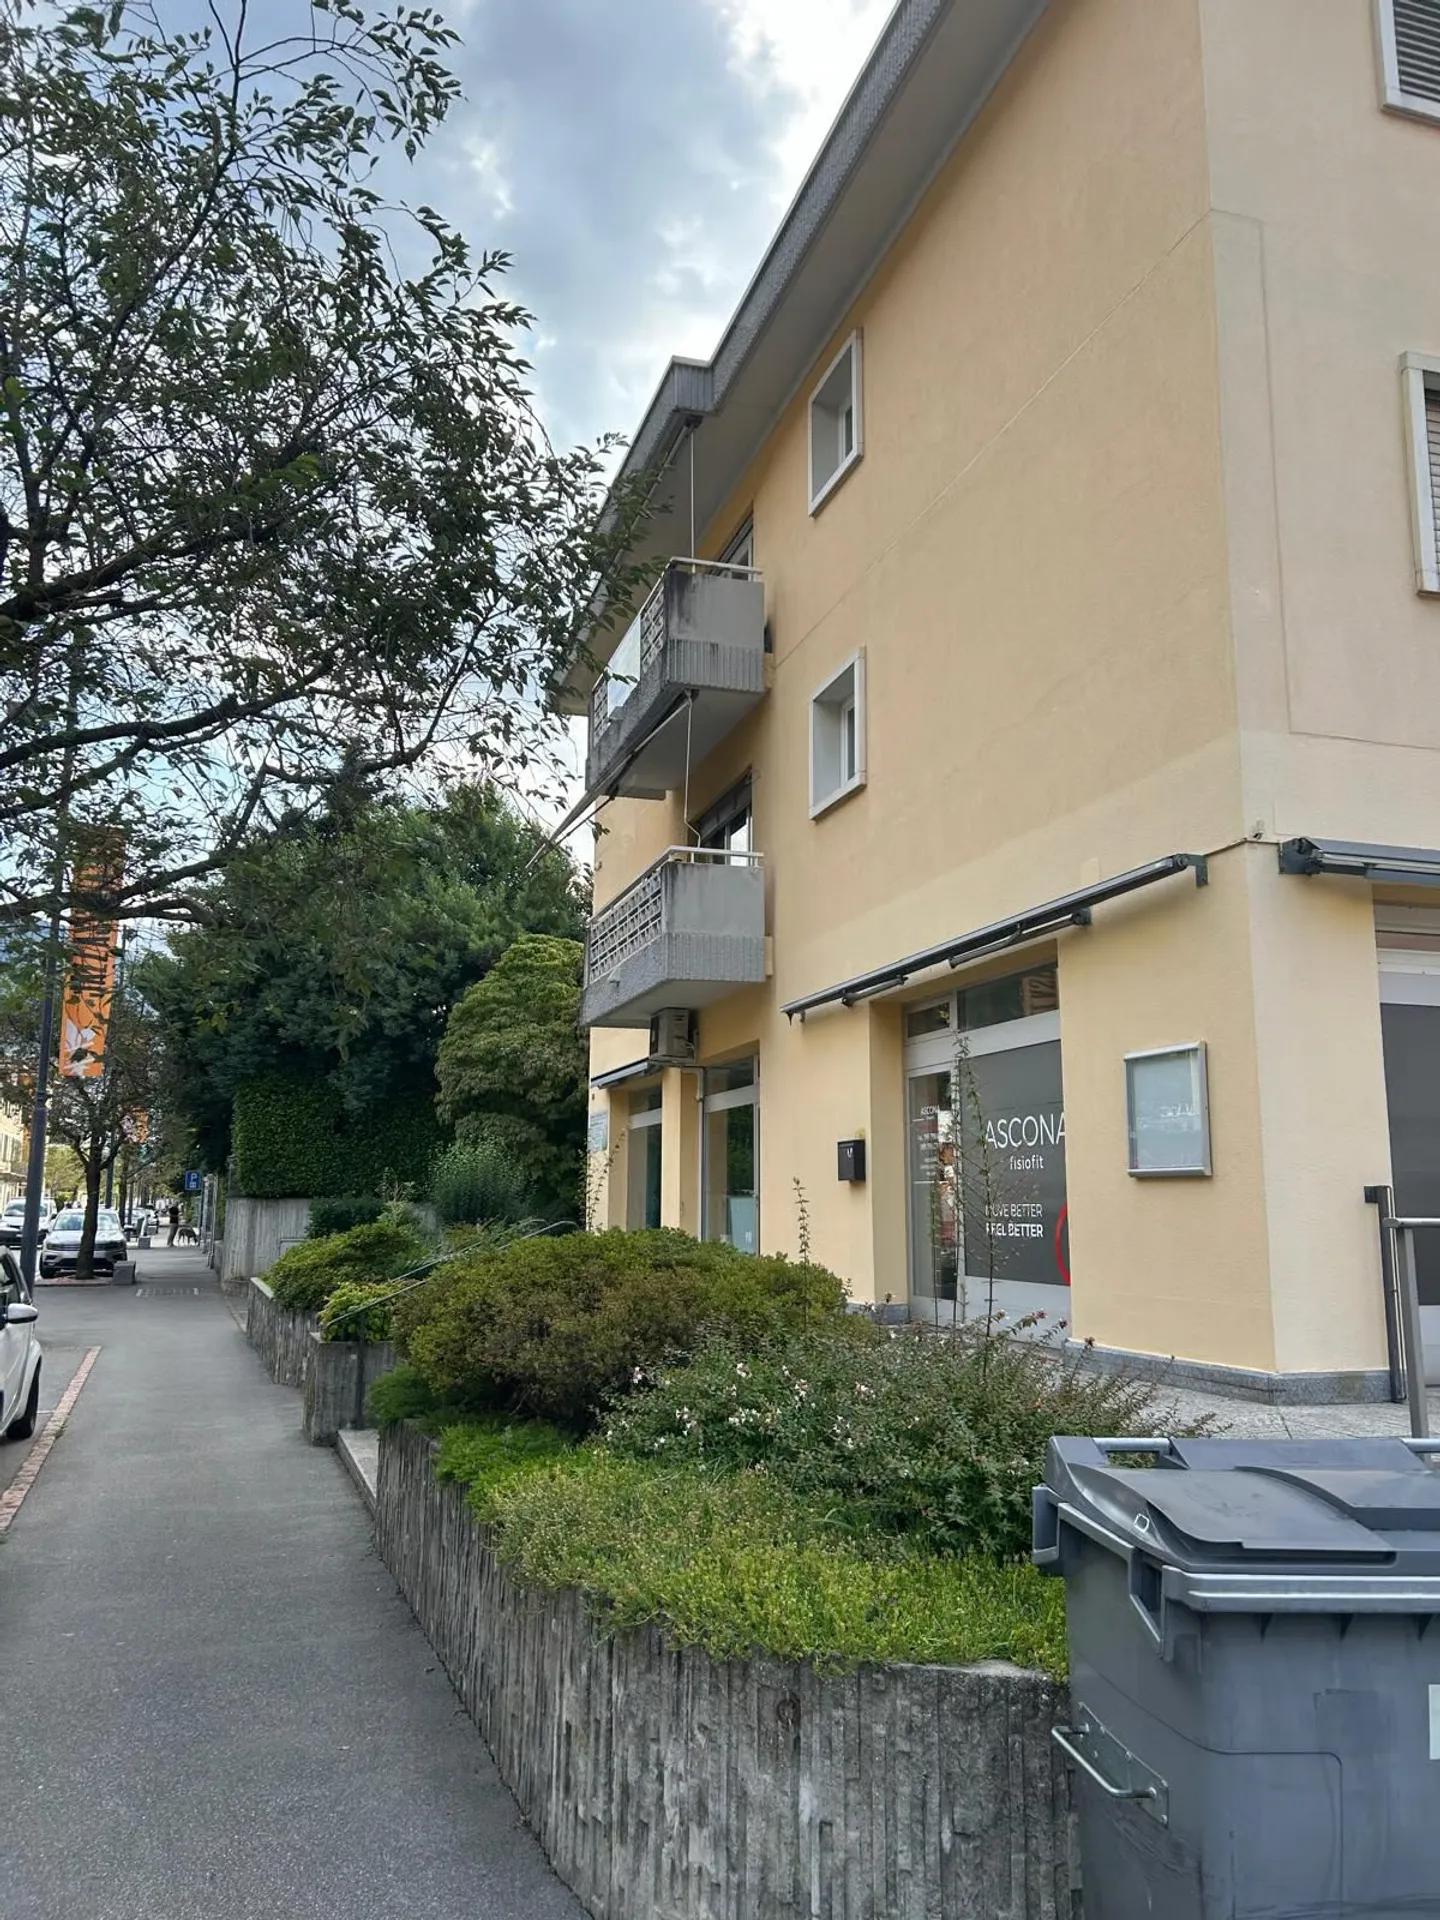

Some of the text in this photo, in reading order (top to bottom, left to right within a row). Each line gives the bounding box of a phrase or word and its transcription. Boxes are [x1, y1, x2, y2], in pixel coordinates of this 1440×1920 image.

[984, 1112, 1066, 1149] ASCONA
[1009, 1154, 1044, 1170] fisiofit
[190, 1172, 198, 1183] P
[1010, 1203, 1043, 1217] BETTER
[1008, 1222, 1044, 1238] BETTER
